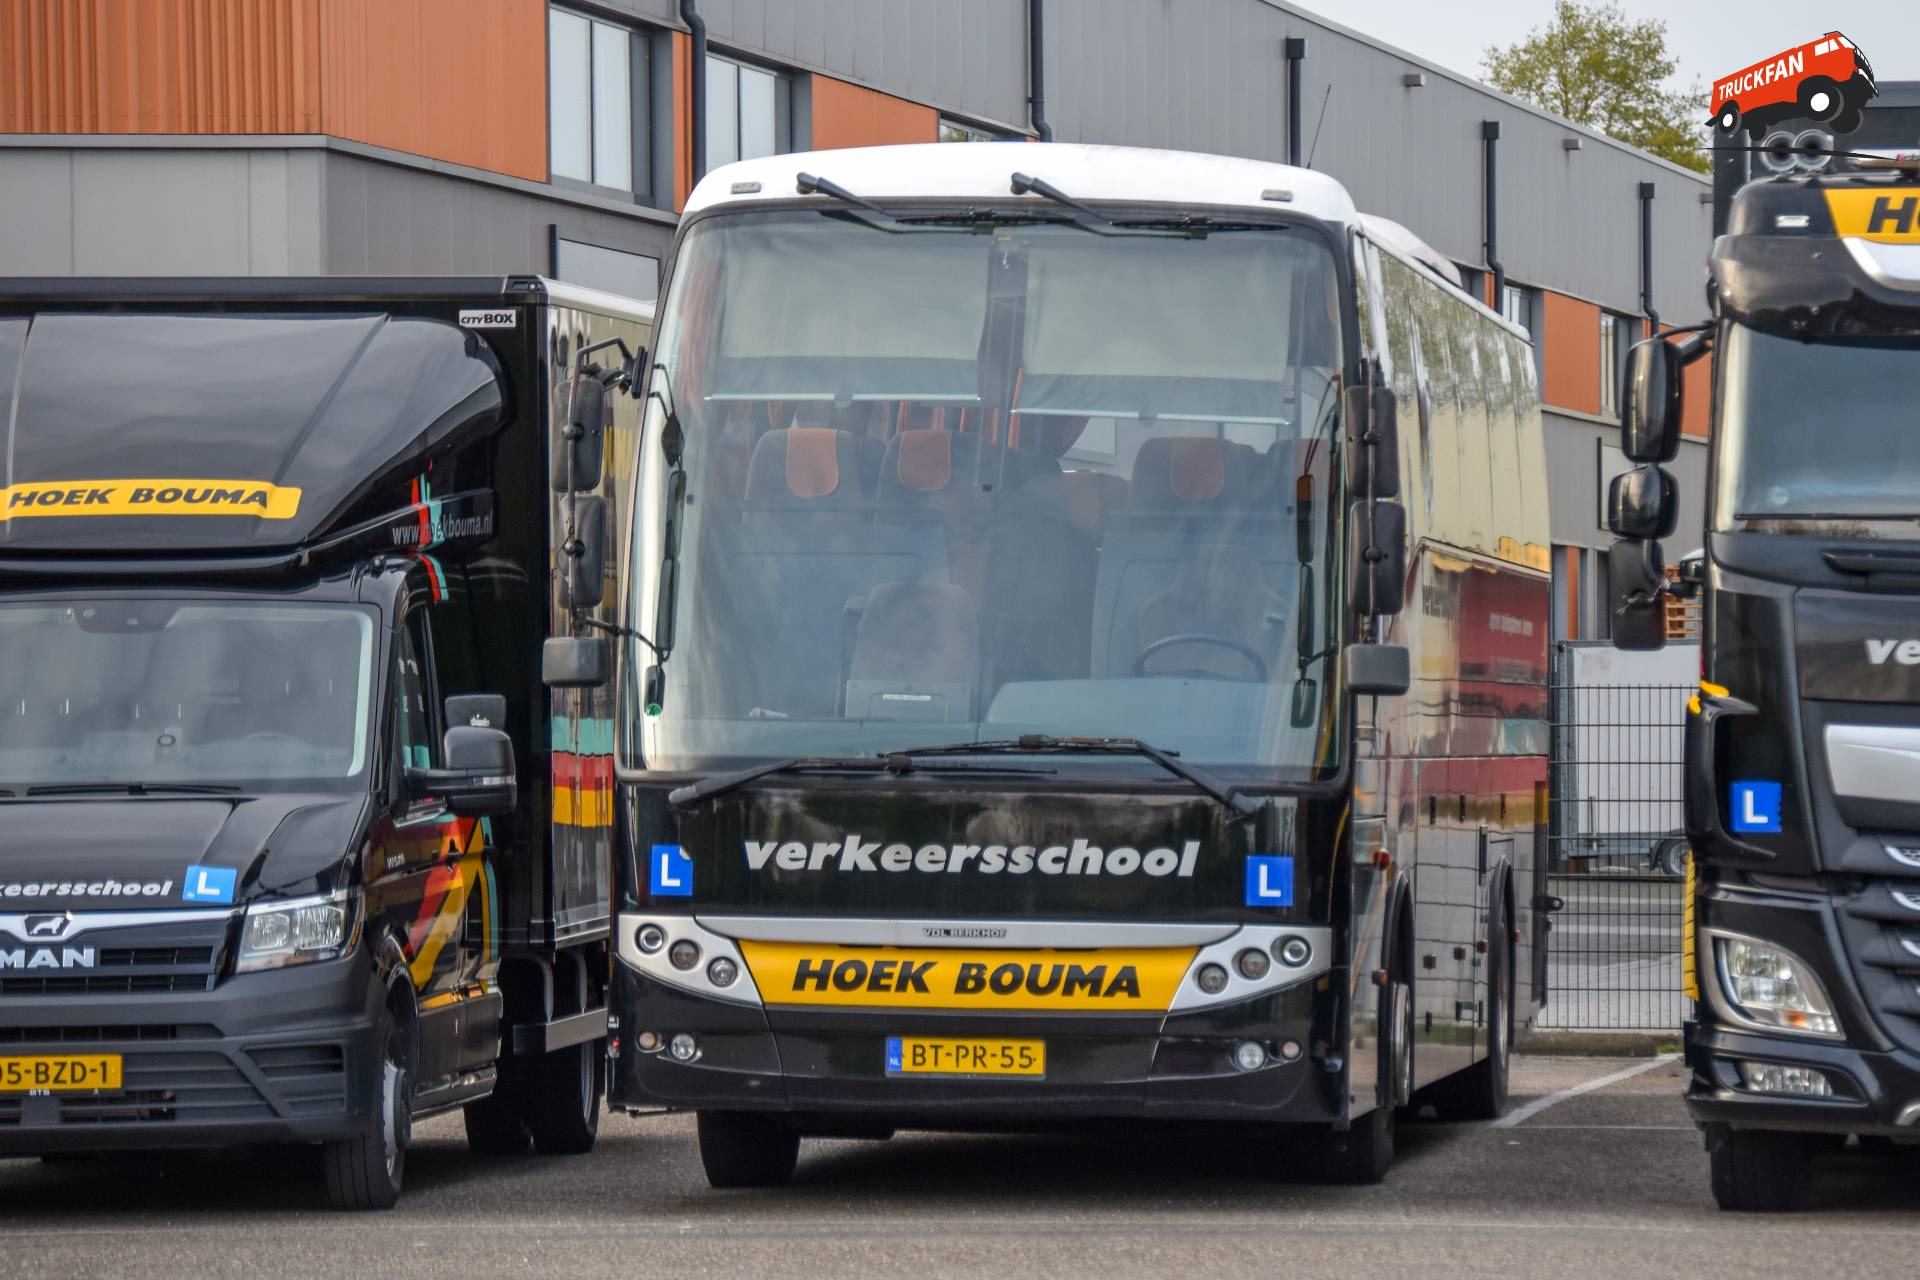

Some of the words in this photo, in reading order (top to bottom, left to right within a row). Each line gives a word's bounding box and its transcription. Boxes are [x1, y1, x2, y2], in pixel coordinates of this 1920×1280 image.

[1867, 196, 1920, 234] H
[8, 488, 118, 509] HOEK
[128, 487, 268, 510] BOUMA
[392, 509, 493, 545] wwwoekbouma.nl
[1743, 790, 1768, 824] L
[660, 853, 681, 887] L
[744, 835, 1201, 877] verkeersschool
[197, 871, 220, 895] L
[1259, 864, 1281, 897] L
[950, 927, 1008, 938] BERKHOF
[0, 946, 95, 968] MAN
[792, 959, 939, 994] HOEK
[954, 962, 1141, 999] BOUMA
[889, 1057, 901, 1066] NL
[912, 1044, 1033, 1070] BT-PR-55
[0, 1060, 108, 1085] 5-BZD-1
